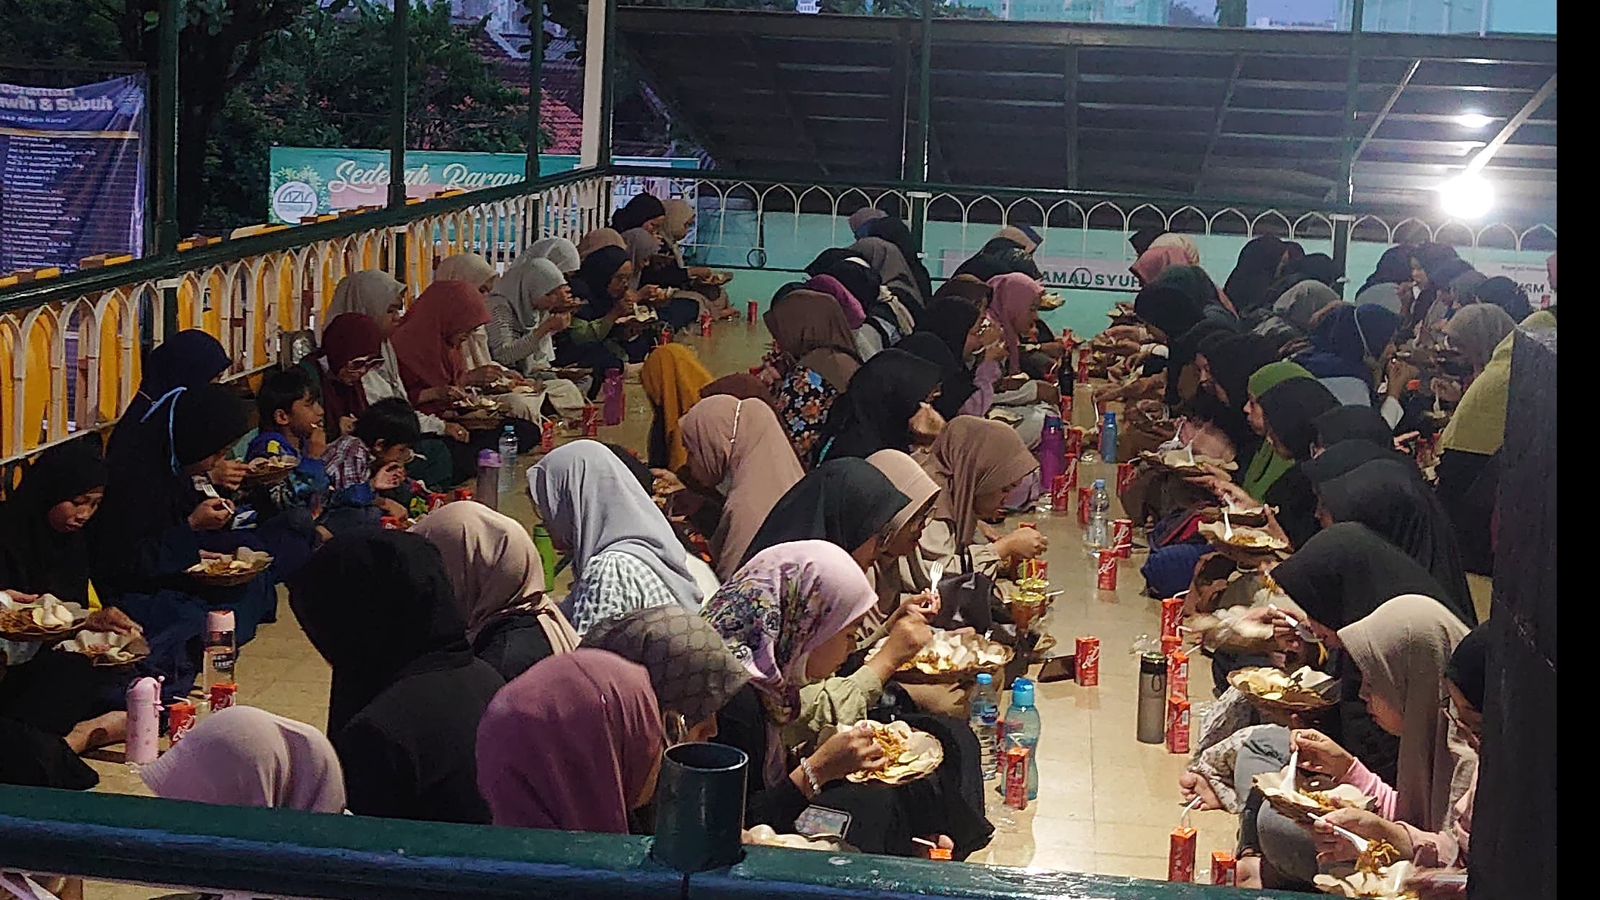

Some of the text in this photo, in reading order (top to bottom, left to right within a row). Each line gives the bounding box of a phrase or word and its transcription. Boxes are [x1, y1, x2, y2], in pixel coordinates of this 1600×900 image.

[39, 98, 53, 111] &
[56, 96, 113, 112] Subuh
[328, 160, 430, 193] Sedeah
